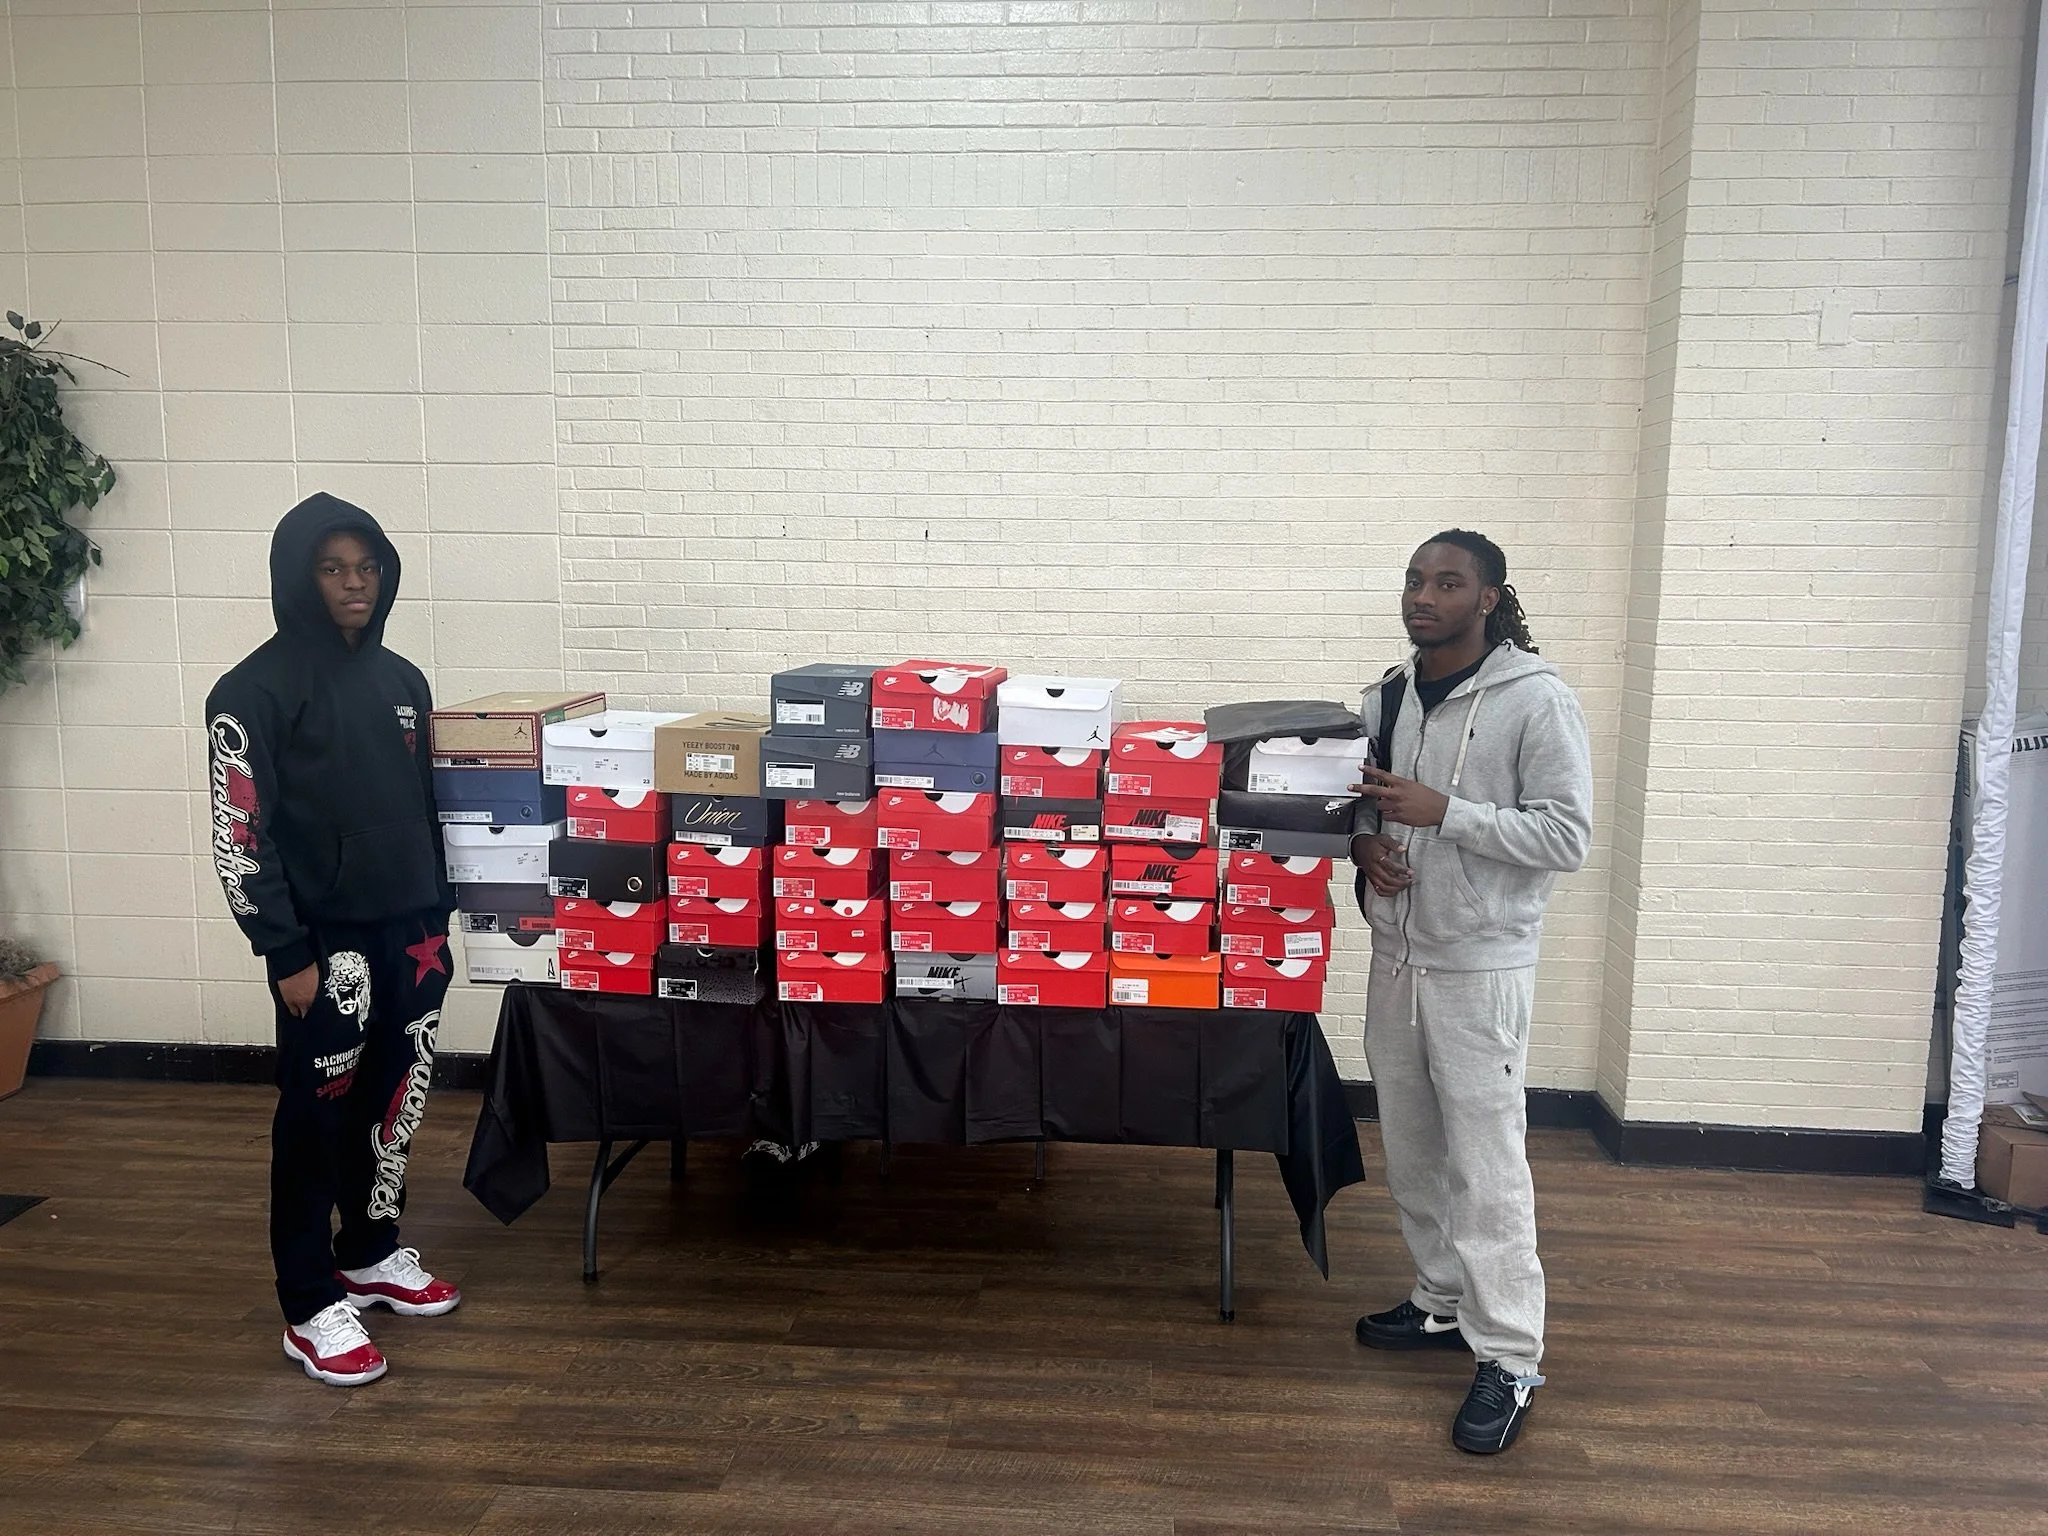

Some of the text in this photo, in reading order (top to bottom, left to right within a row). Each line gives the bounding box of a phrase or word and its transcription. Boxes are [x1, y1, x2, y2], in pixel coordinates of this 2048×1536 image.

[683, 741, 703, 749] YEEZY
[685, 802, 748, 830] Union
[1032, 814, 1068, 829] NIKE
[1142, 864, 1179, 881] NIKE
[927, 966, 960, 979] NIKE
